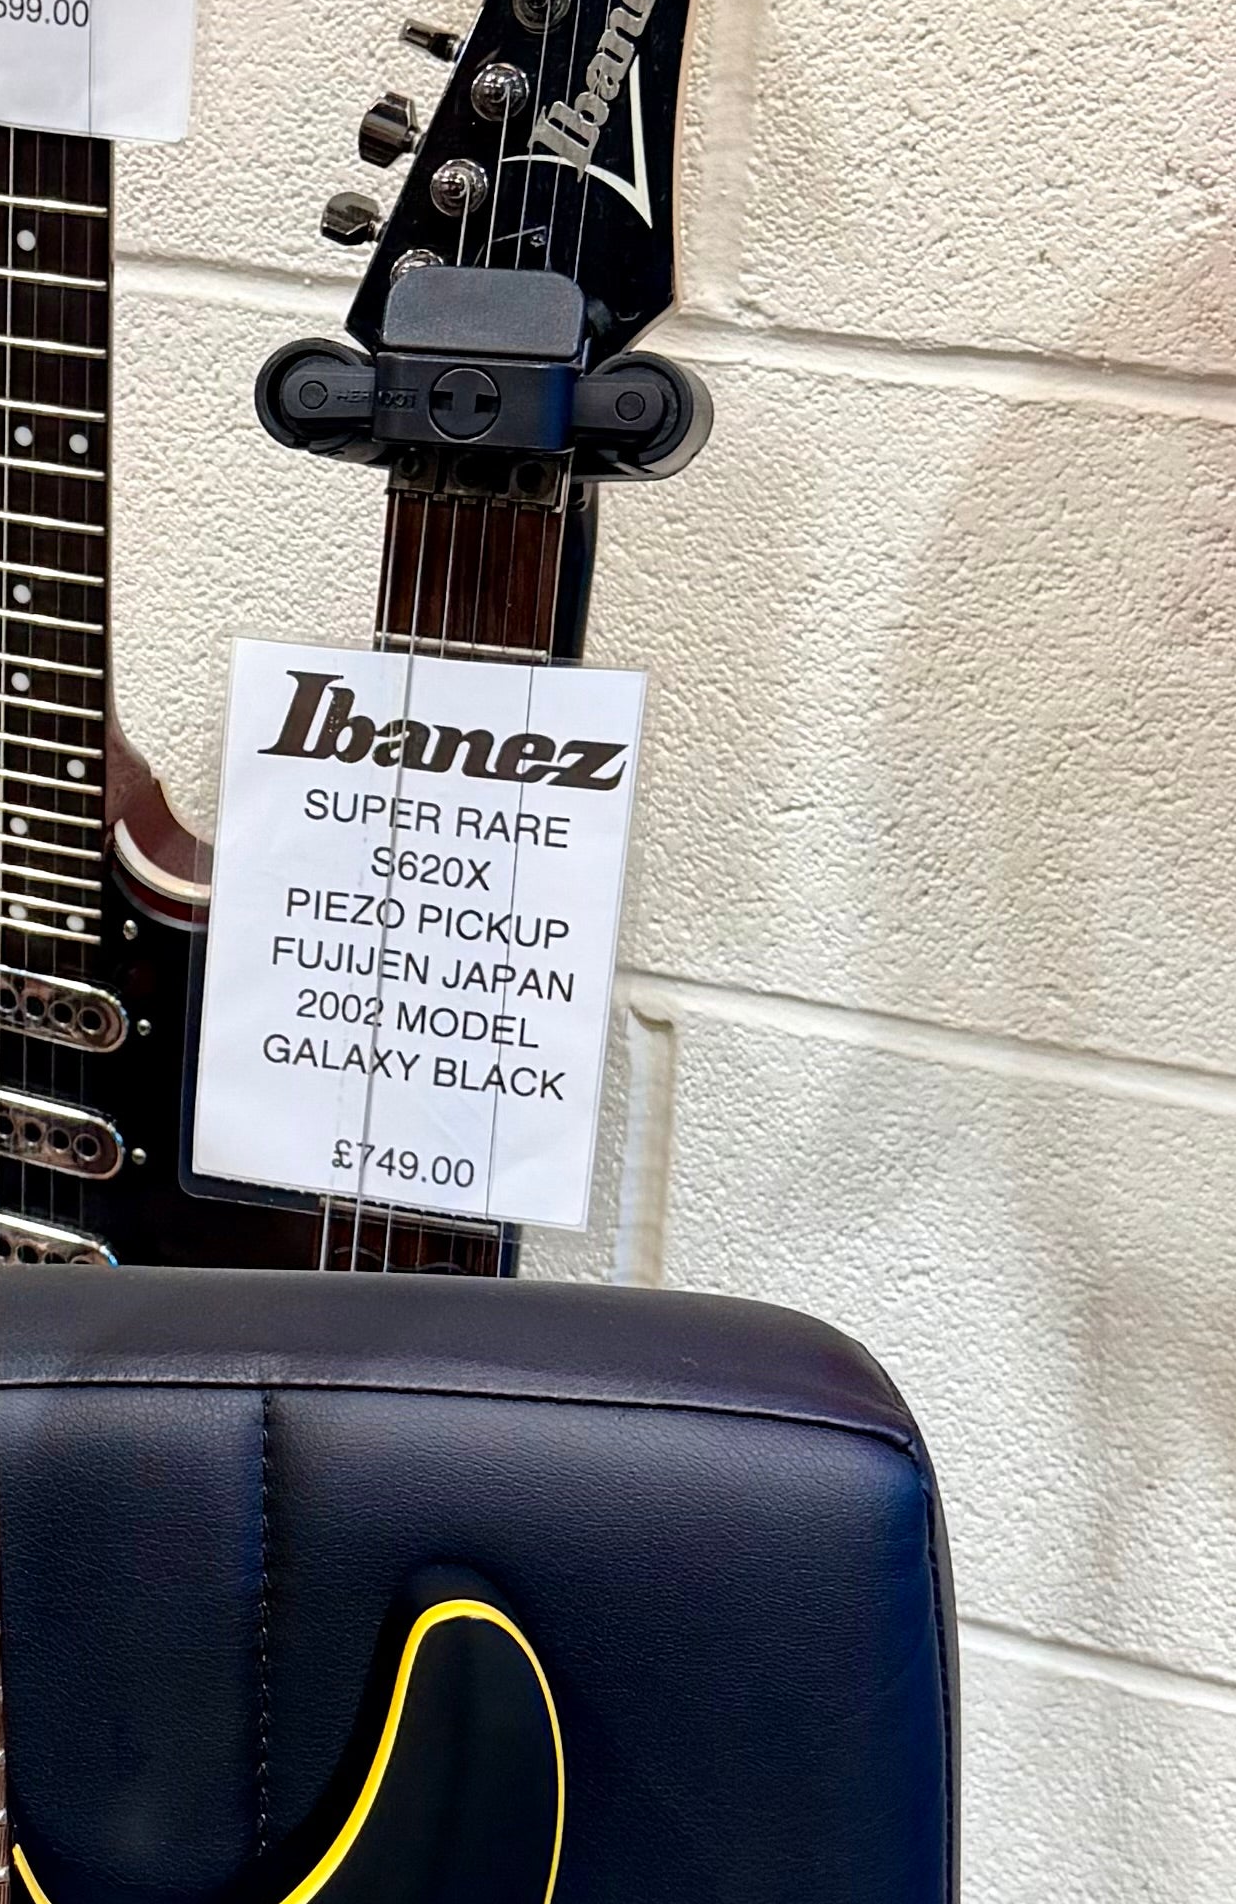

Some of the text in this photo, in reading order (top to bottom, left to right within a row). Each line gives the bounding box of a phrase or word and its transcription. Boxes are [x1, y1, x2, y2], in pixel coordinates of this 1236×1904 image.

[257, 670, 629, 791] Ibanez
[304, 788, 571, 848] SUPER RARE
[370, 847, 492, 891] S620X
[285, 888, 569, 950] PIEZO PICKUP
[272, 937, 575, 1002] FUJIJEN JAPAN
[295, 990, 539, 1049] 2002 MODEL
[263, 1035, 566, 1101] GALAXY BLACK
[331, 1139, 475, 1187] £749.00
